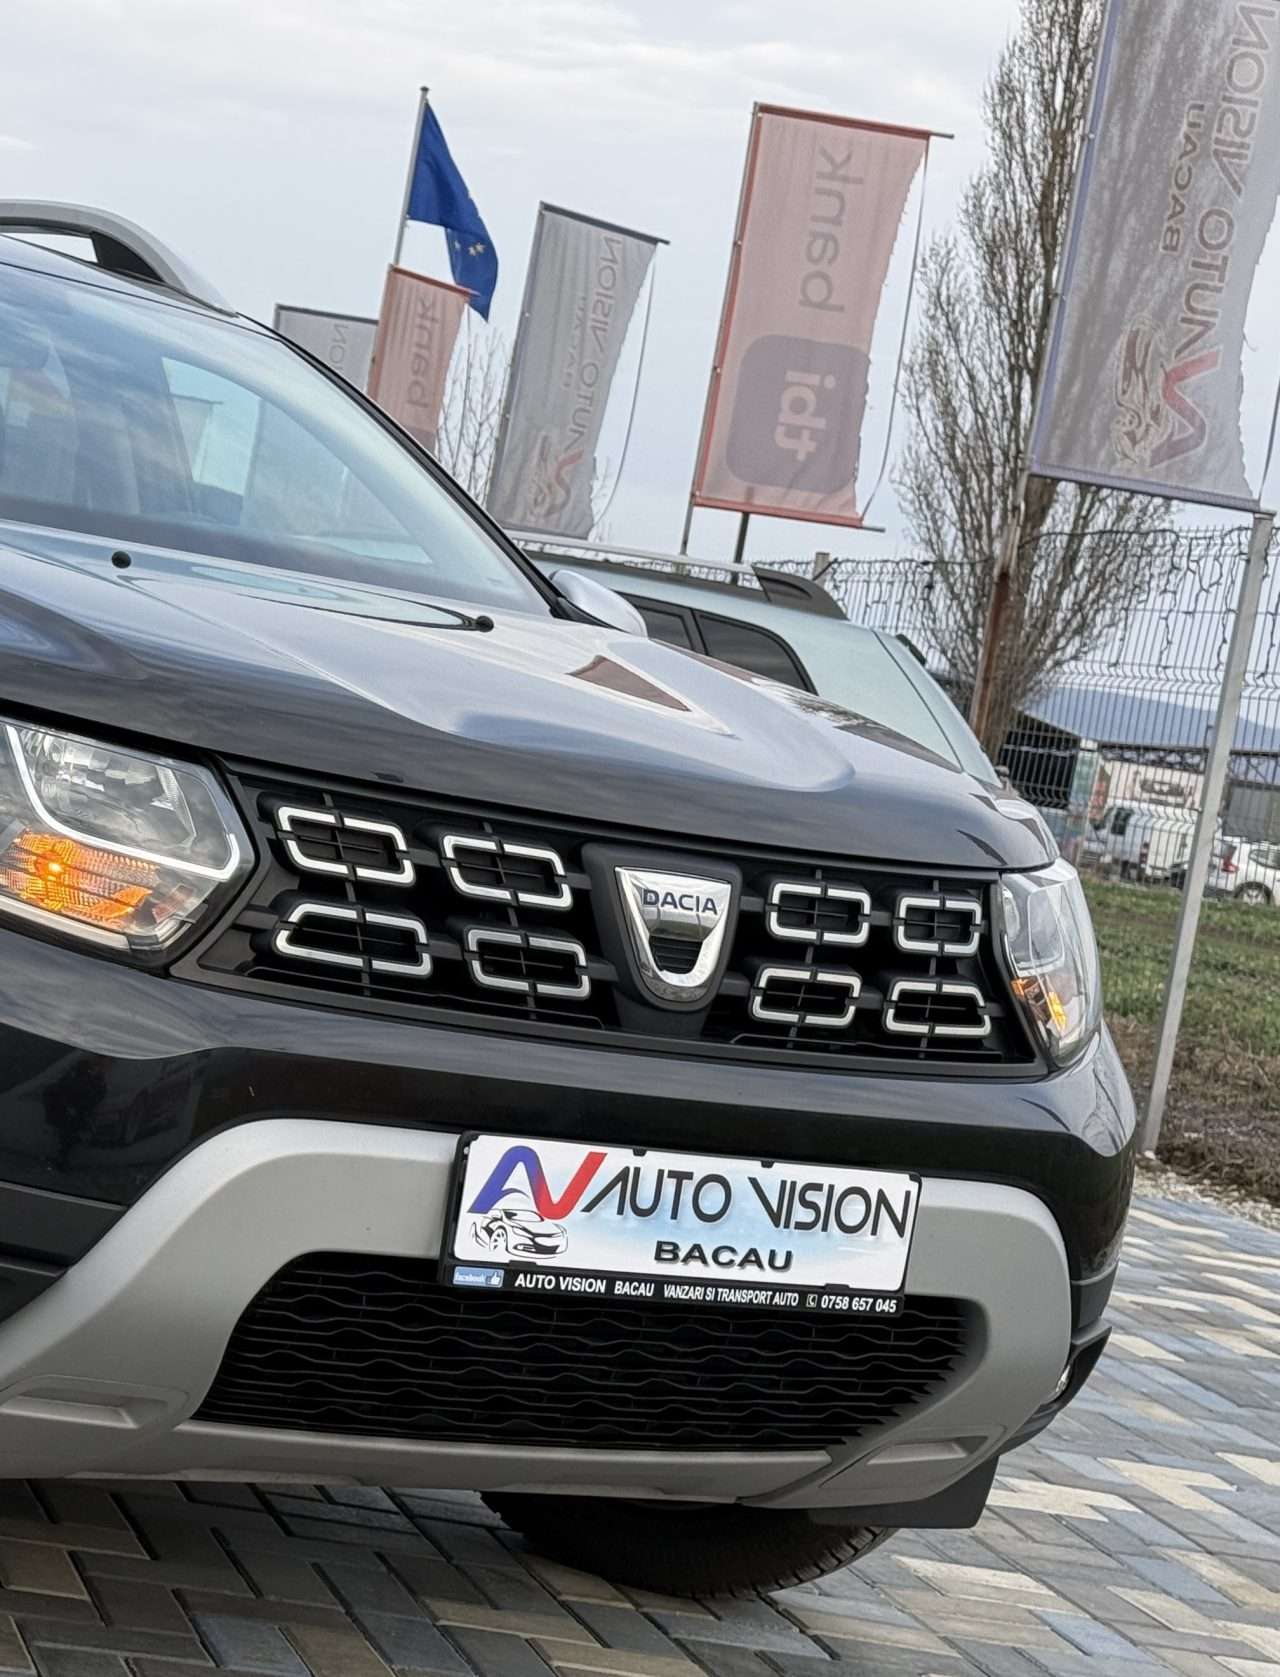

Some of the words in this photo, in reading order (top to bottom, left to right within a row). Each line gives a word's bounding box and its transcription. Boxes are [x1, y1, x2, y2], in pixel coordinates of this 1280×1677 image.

[643, 889, 718, 915] DACIA
[582, 1165, 732, 1223] AUTO
[748, 1176, 911, 1239] VISION
[654, 1240, 793, 1272] BACAU
[515, 1273, 556, 1289] AUTO
[559, 1277, 607, 1293] VISION
[614, 1281, 655, 1297] BACAU
[663, 1284, 704, 1300] VANZARI
[705, 1289, 716, 1301] SI
[717, 1288, 772, 1305] TRANSPORT
[772, 1293, 799, 1306] AUTO
[821, 1295, 849, 1310] 0758
[852, 1297, 874, 1311] 657
[875, 1298, 897, 1313] 045
